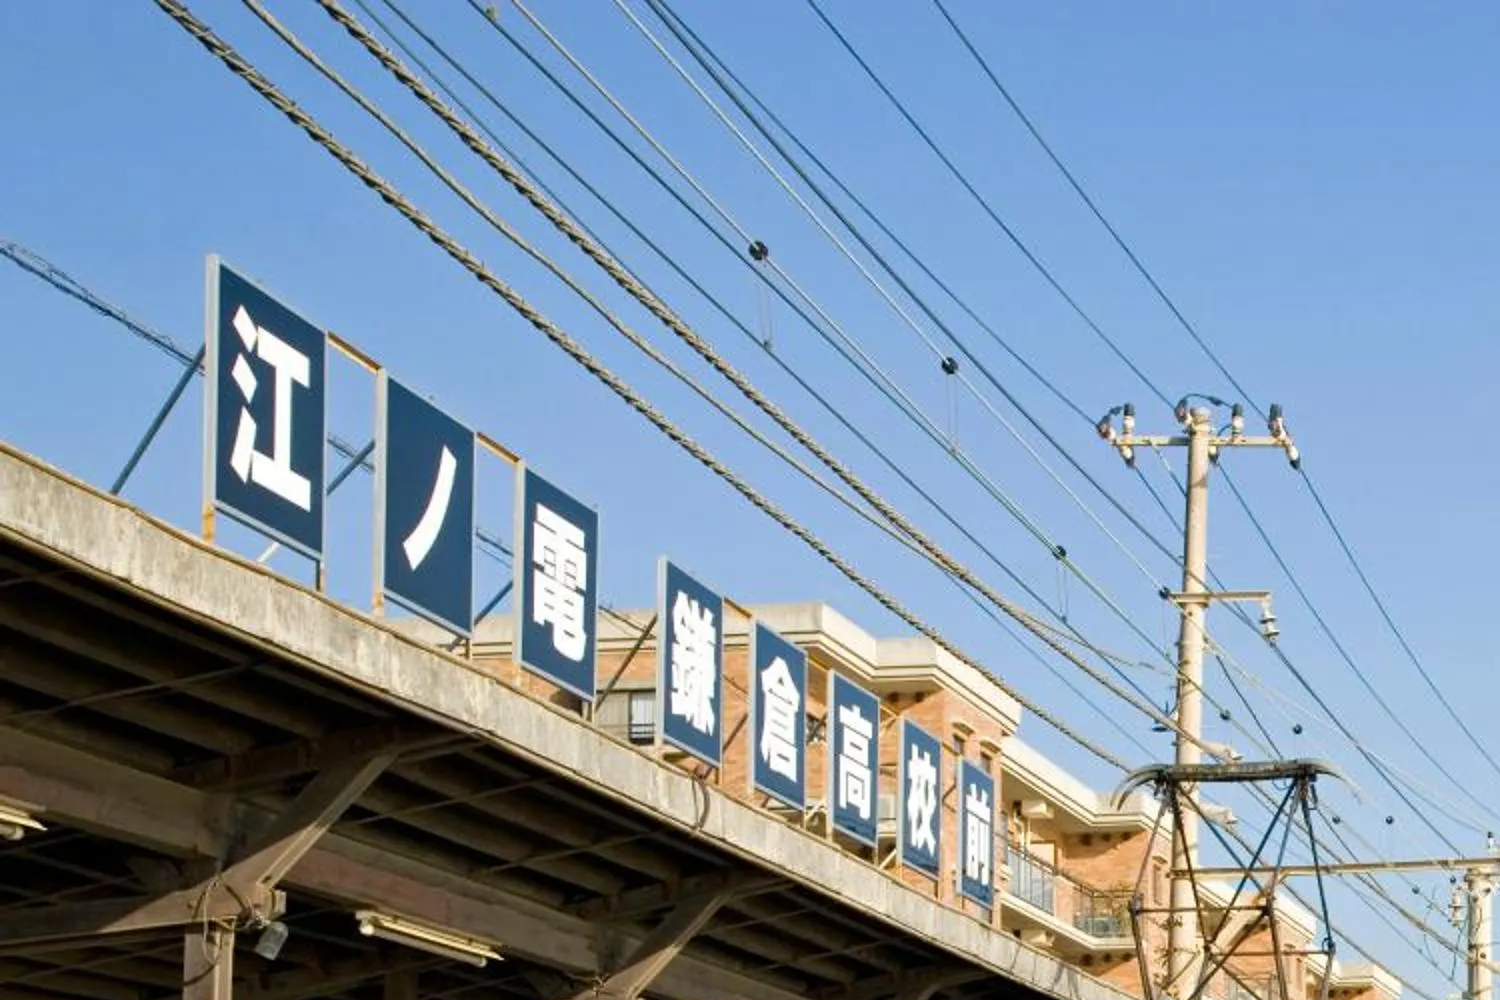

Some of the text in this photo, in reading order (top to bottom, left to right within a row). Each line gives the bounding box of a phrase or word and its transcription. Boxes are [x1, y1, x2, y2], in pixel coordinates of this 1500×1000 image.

[231, 303, 991, 889] 江ノ電 鎌倉高校前
